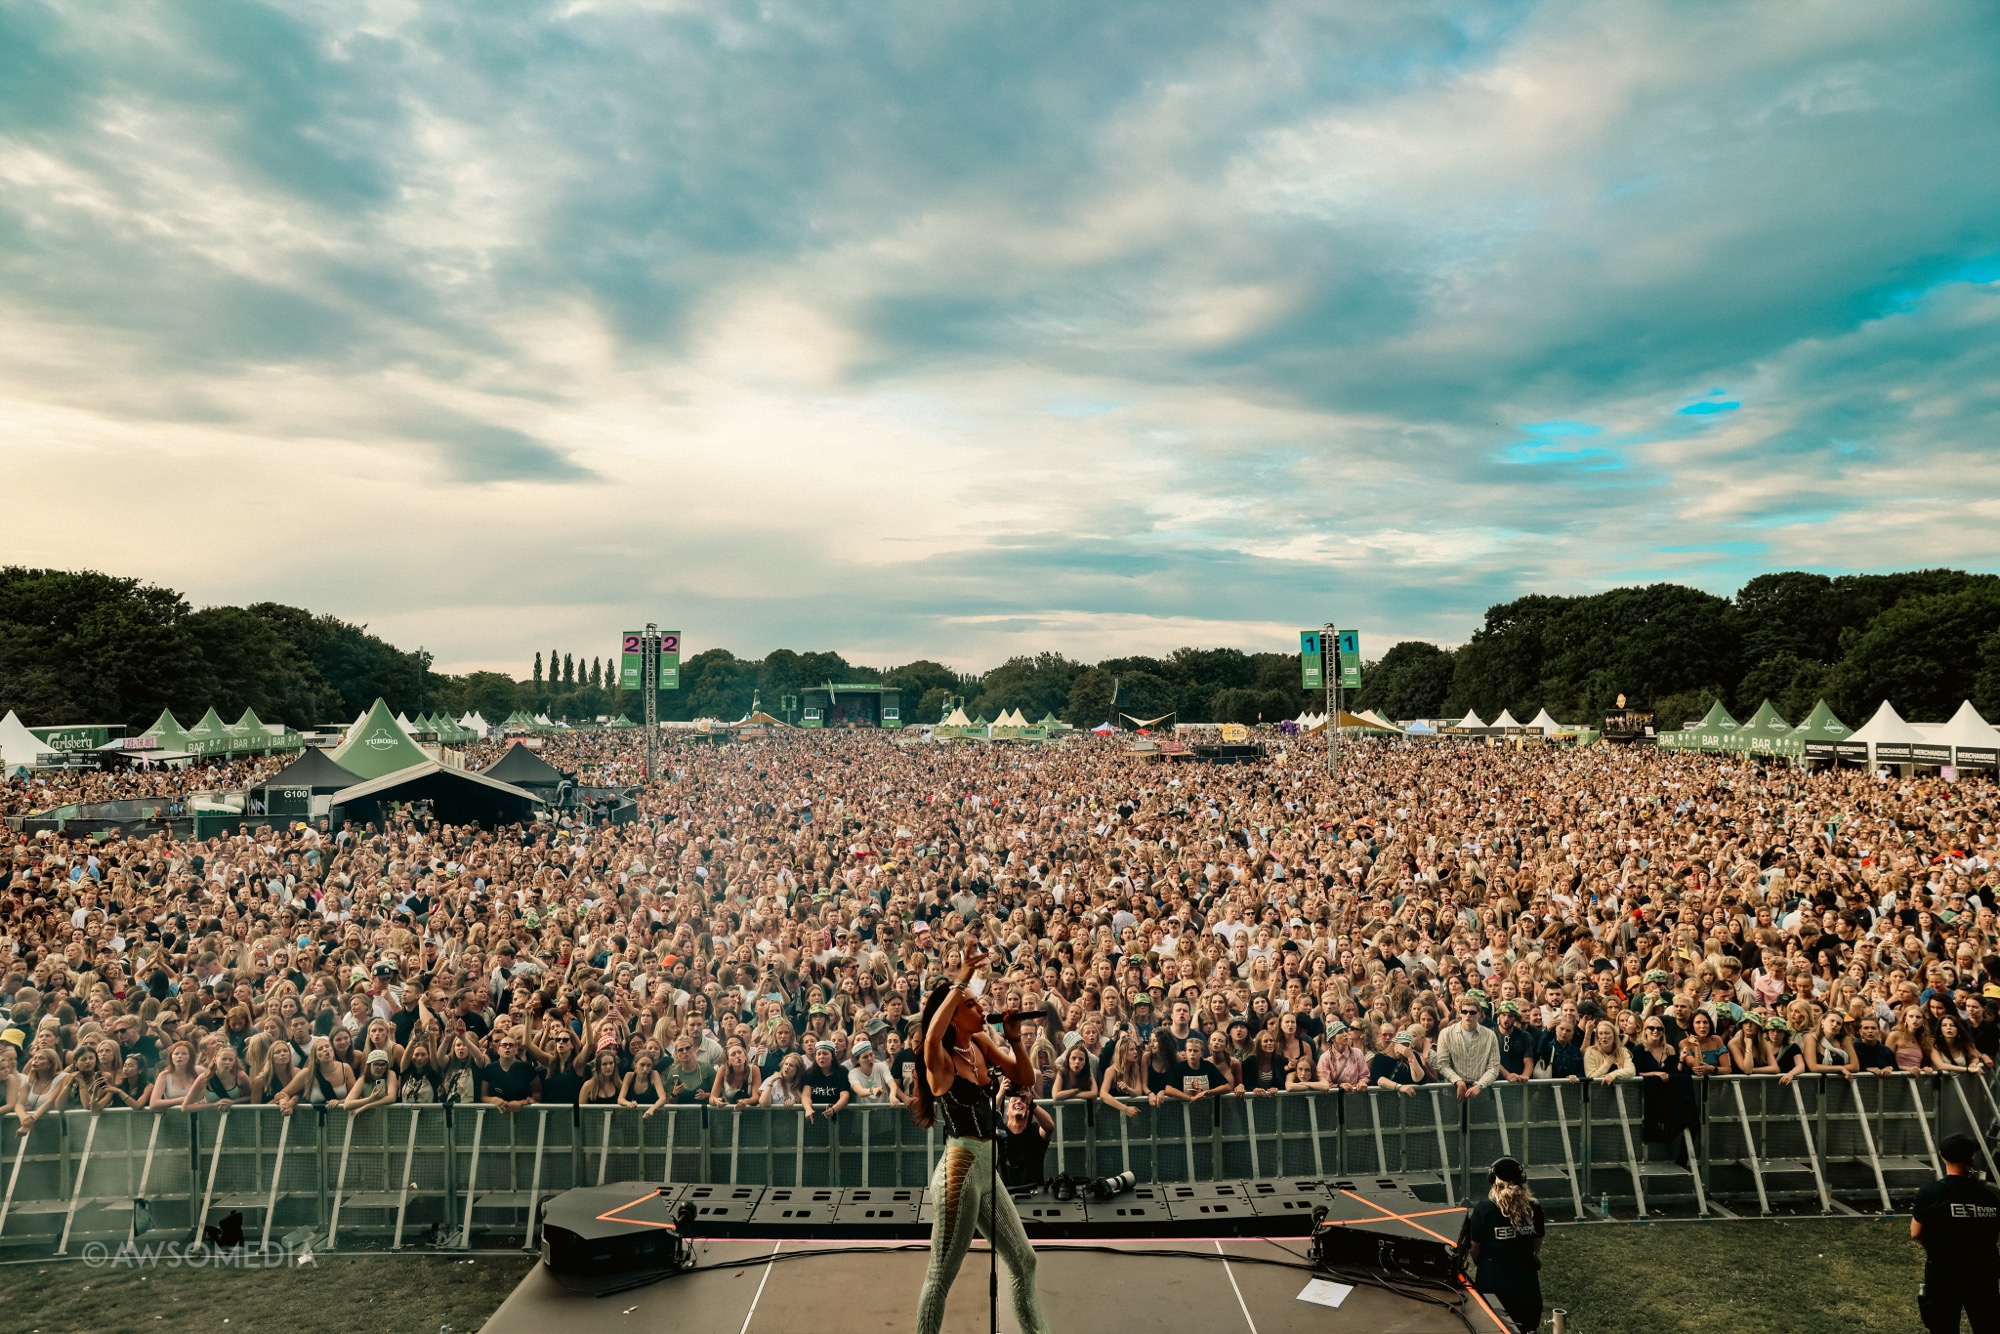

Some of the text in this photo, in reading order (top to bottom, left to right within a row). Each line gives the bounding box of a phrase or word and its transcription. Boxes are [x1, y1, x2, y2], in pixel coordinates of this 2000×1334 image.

[624, 637, 640, 653] 2
[663, 636, 678, 652] 2
[1306, 636, 1315, 652] 1
[1344, 635, 1354, 651] 1
[46, 732, 93, 749] Carlsberg
[233, 739, 248, 749] BAR
[272, 736, 285, 746] BAR
[1659, 735, 1675, 745] BAR
[1702, 735, 1719, 746] BAR
[1751, 738, 1771, 750] BAR
[188, 743, 205, 753] BAR
[1806, 744, 1834, 752] MERCHANDISE
[1836, 745, 1867, 753] MERCHANDISE
[1877, 747, 1910, 755] MERCHANDISE
[1913, 748, 1950, 758] MERCHANDISE
[1957, 752, 1997, 761] MERCHANDISE
[284, 790, 308, 798] G100
